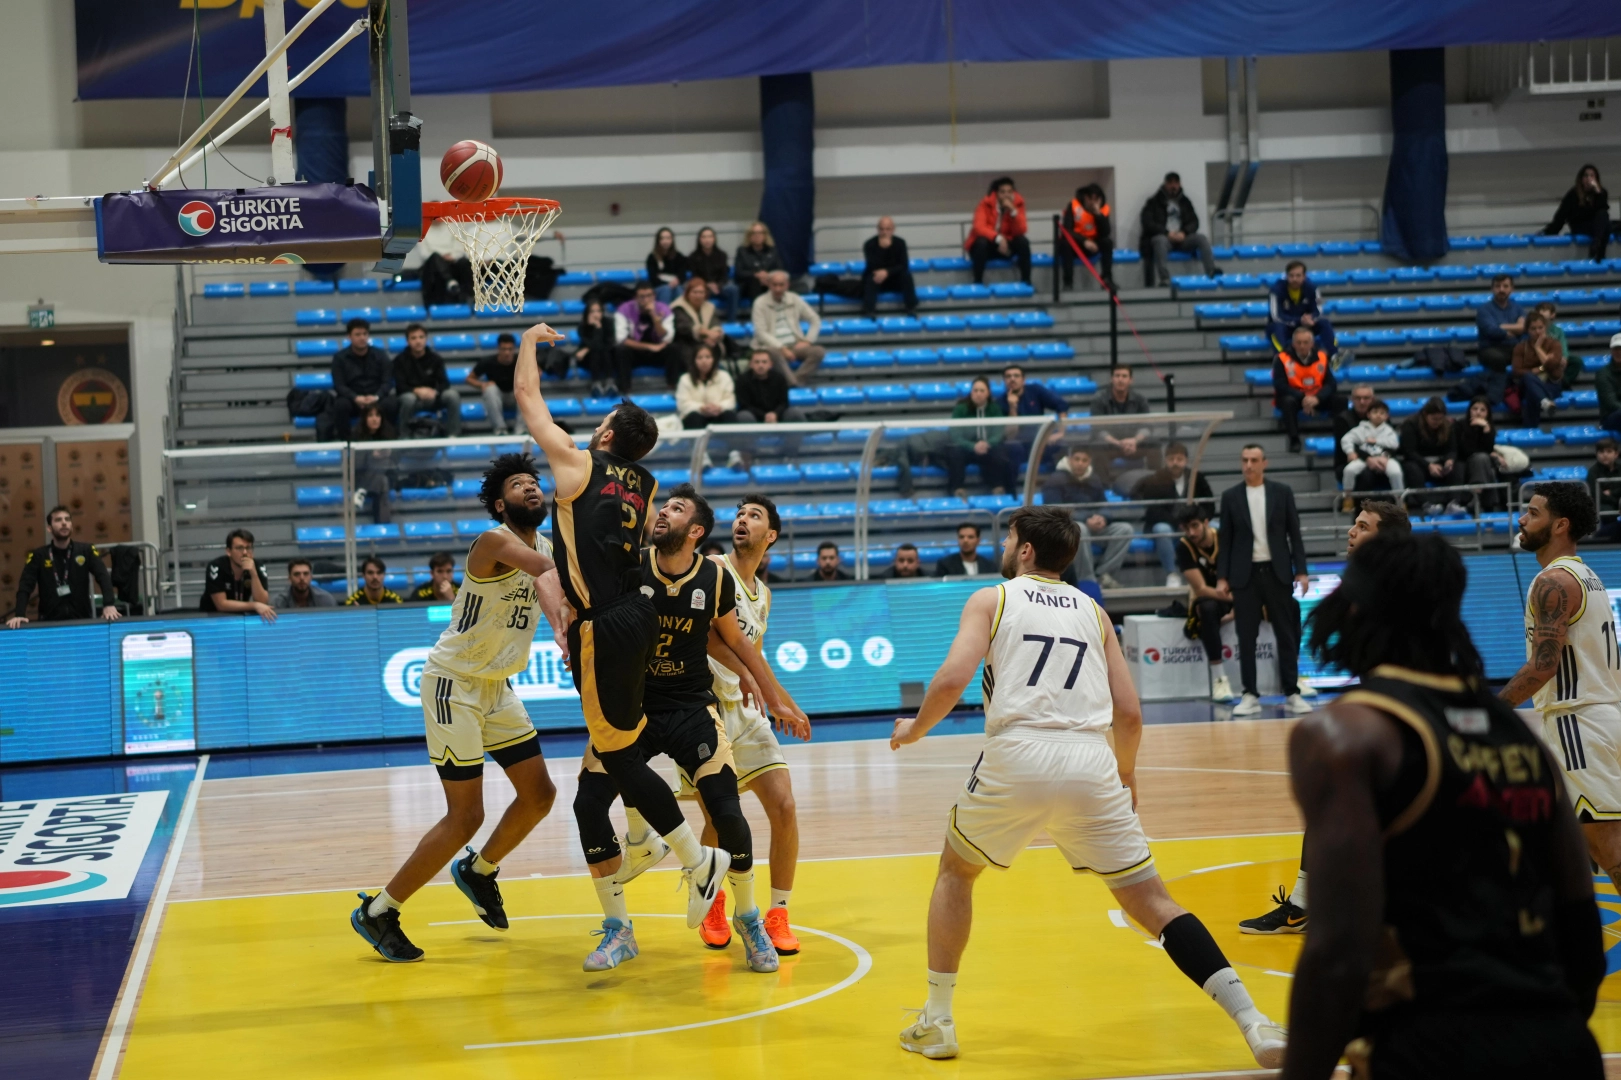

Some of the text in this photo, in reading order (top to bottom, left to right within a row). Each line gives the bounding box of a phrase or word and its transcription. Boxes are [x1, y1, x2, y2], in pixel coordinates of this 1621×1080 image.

[217, 198, 301, 216] TÜRKİYE
[220, 214, 304, 234] SİGORTA
[1023, 589, 1078, 609] YANCI
[506, 604, 532, 630] 35
[658, 615, 694, 634] NYA
[655, 633, 674, 658] 2
[1023, 634, 1088, 690] 77
[13, 794, 139, 866] SİGORTA
